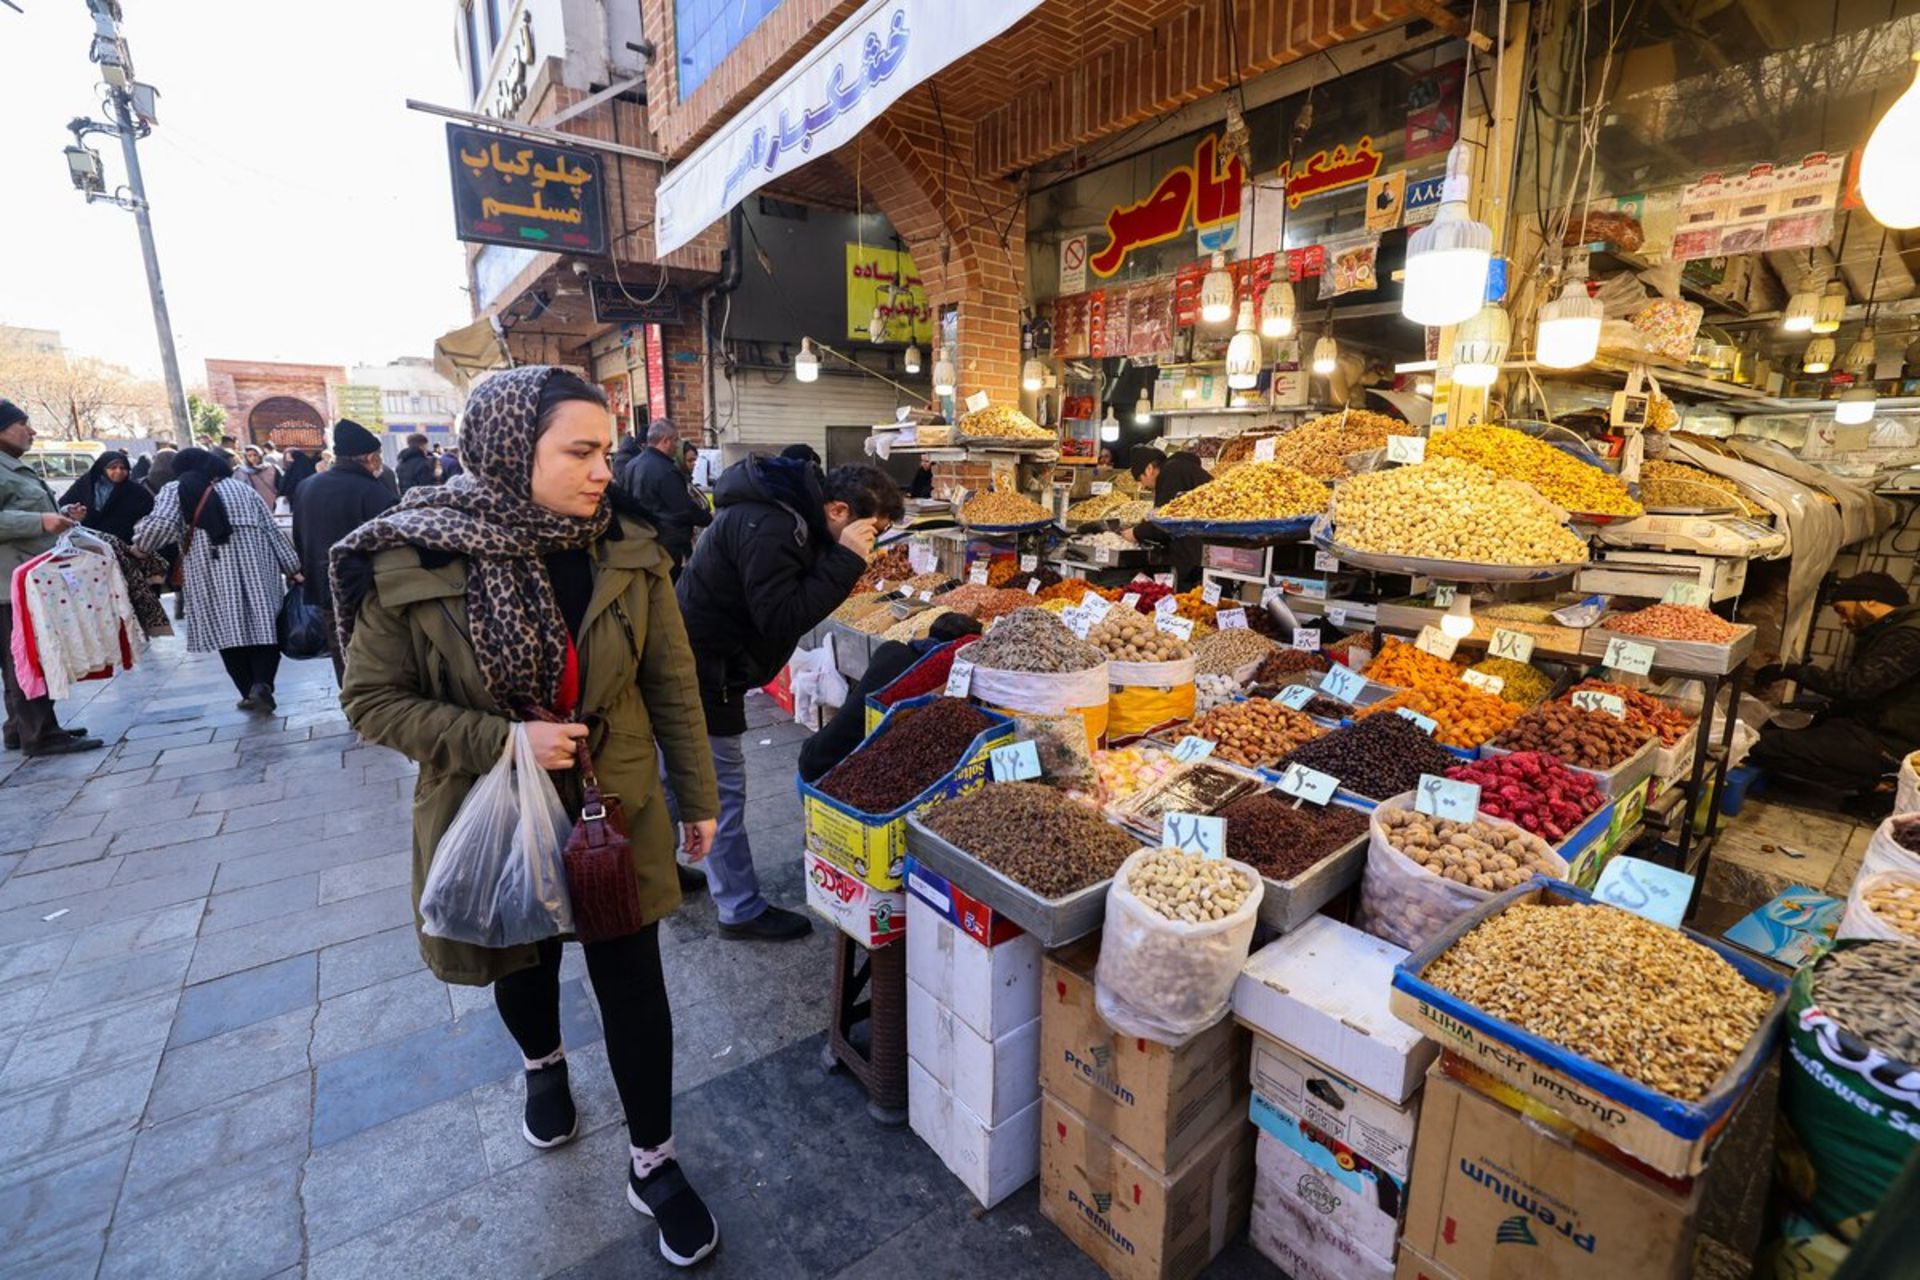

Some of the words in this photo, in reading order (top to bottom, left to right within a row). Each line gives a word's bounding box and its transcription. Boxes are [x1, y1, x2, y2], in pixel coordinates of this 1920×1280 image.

[766, 9, 909, 172] خشکبار
[461, 142, 592, 199] چلوکباب
[1278, 134, 1382, 209] خشکبا
[482, 192, 581, 223] مسلم
[1496, 631, 1521, 657] ۲۸۰
[994, 750, 1025, 781] ۲۲۰
[1167, 816, 1211, 853] ۲۸۰
[1419, 1000, 1474, 1043] WHITE
[1532, 1071, 1627, 1128] استهبان
[1888, 1109, 1920, 1141] Se
[1068, 1189, 1136, 1256] Premium
[1460, 1157, 1596, 1254] Premium
